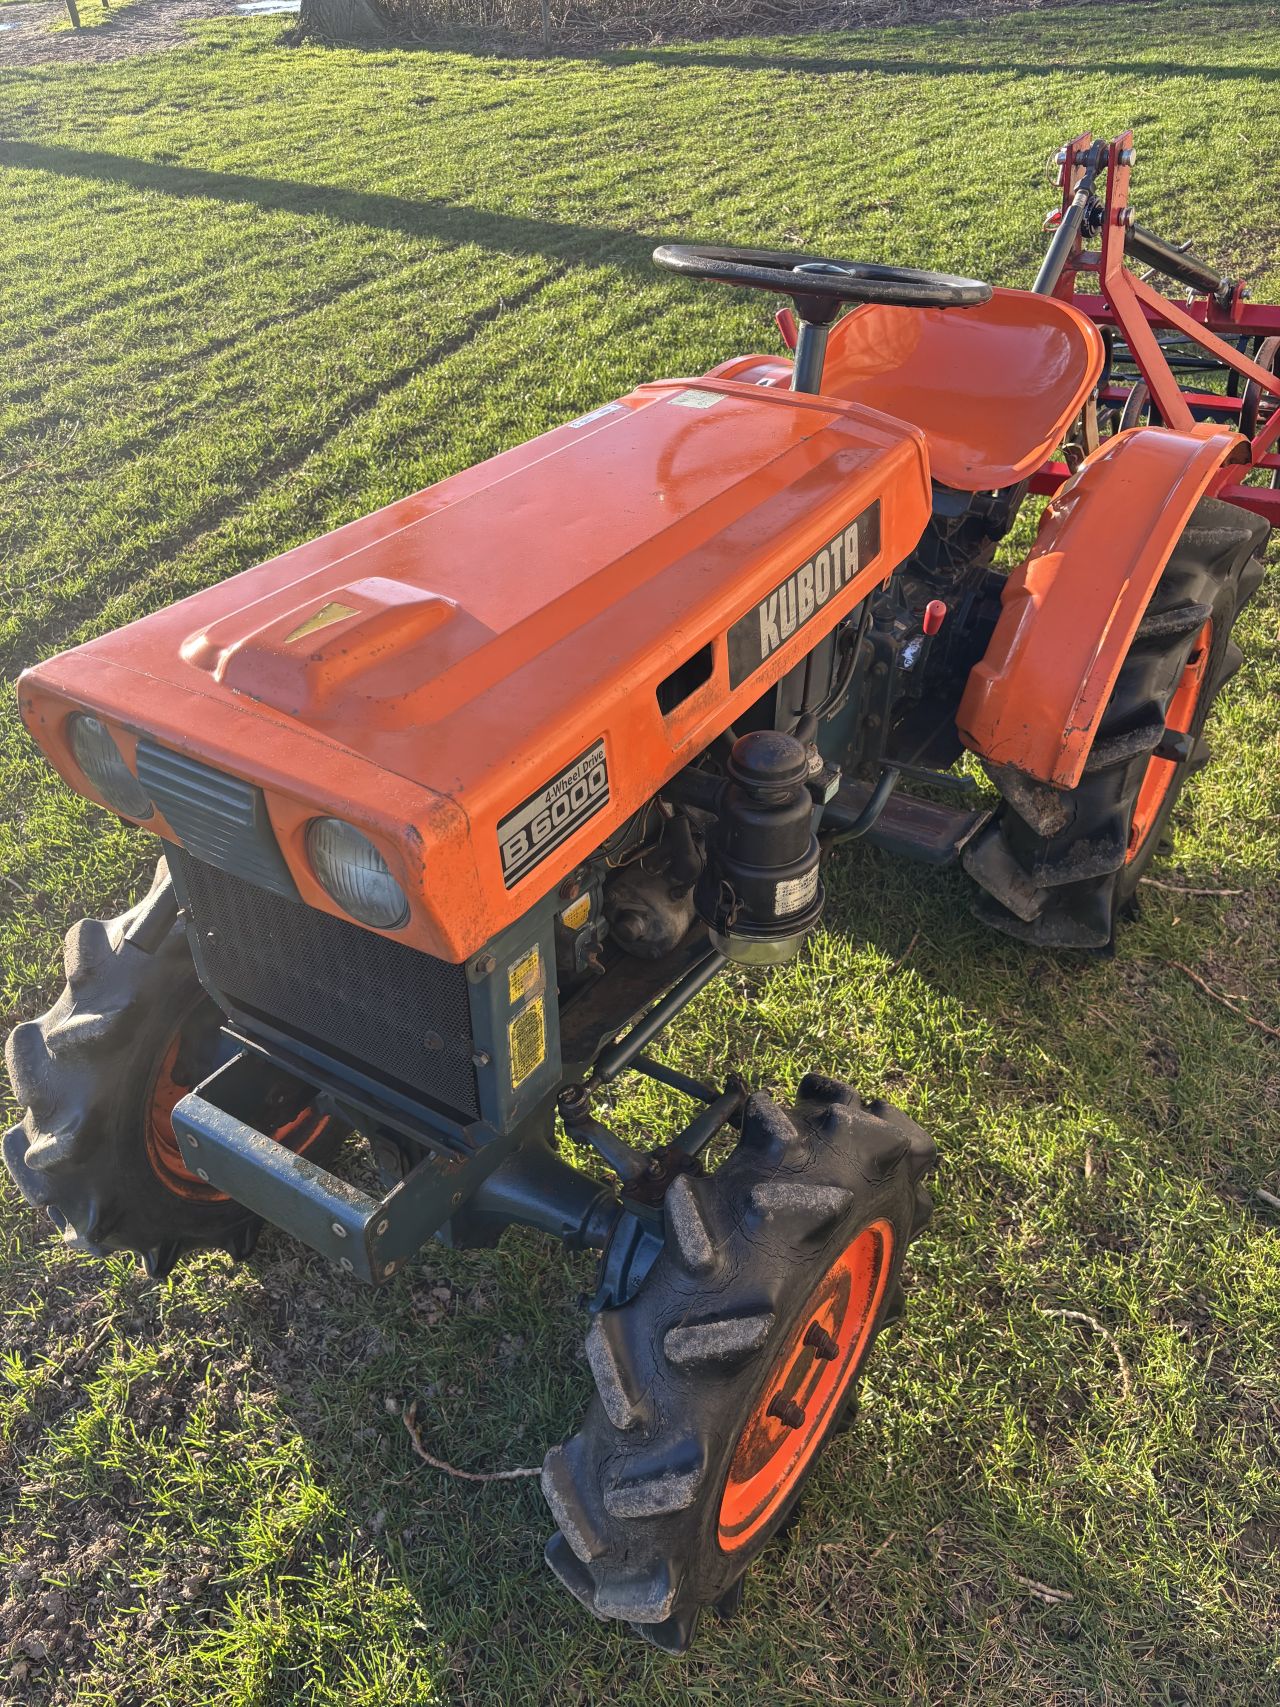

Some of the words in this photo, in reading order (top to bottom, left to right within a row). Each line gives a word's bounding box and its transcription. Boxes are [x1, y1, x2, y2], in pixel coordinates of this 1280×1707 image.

[759, 522, 859, 659] KUBOTA
[531, 763, 606, 843] 6000
[545, 768, 581, 804] 4-Wheel
[583, 750, 604, 773] Drive
